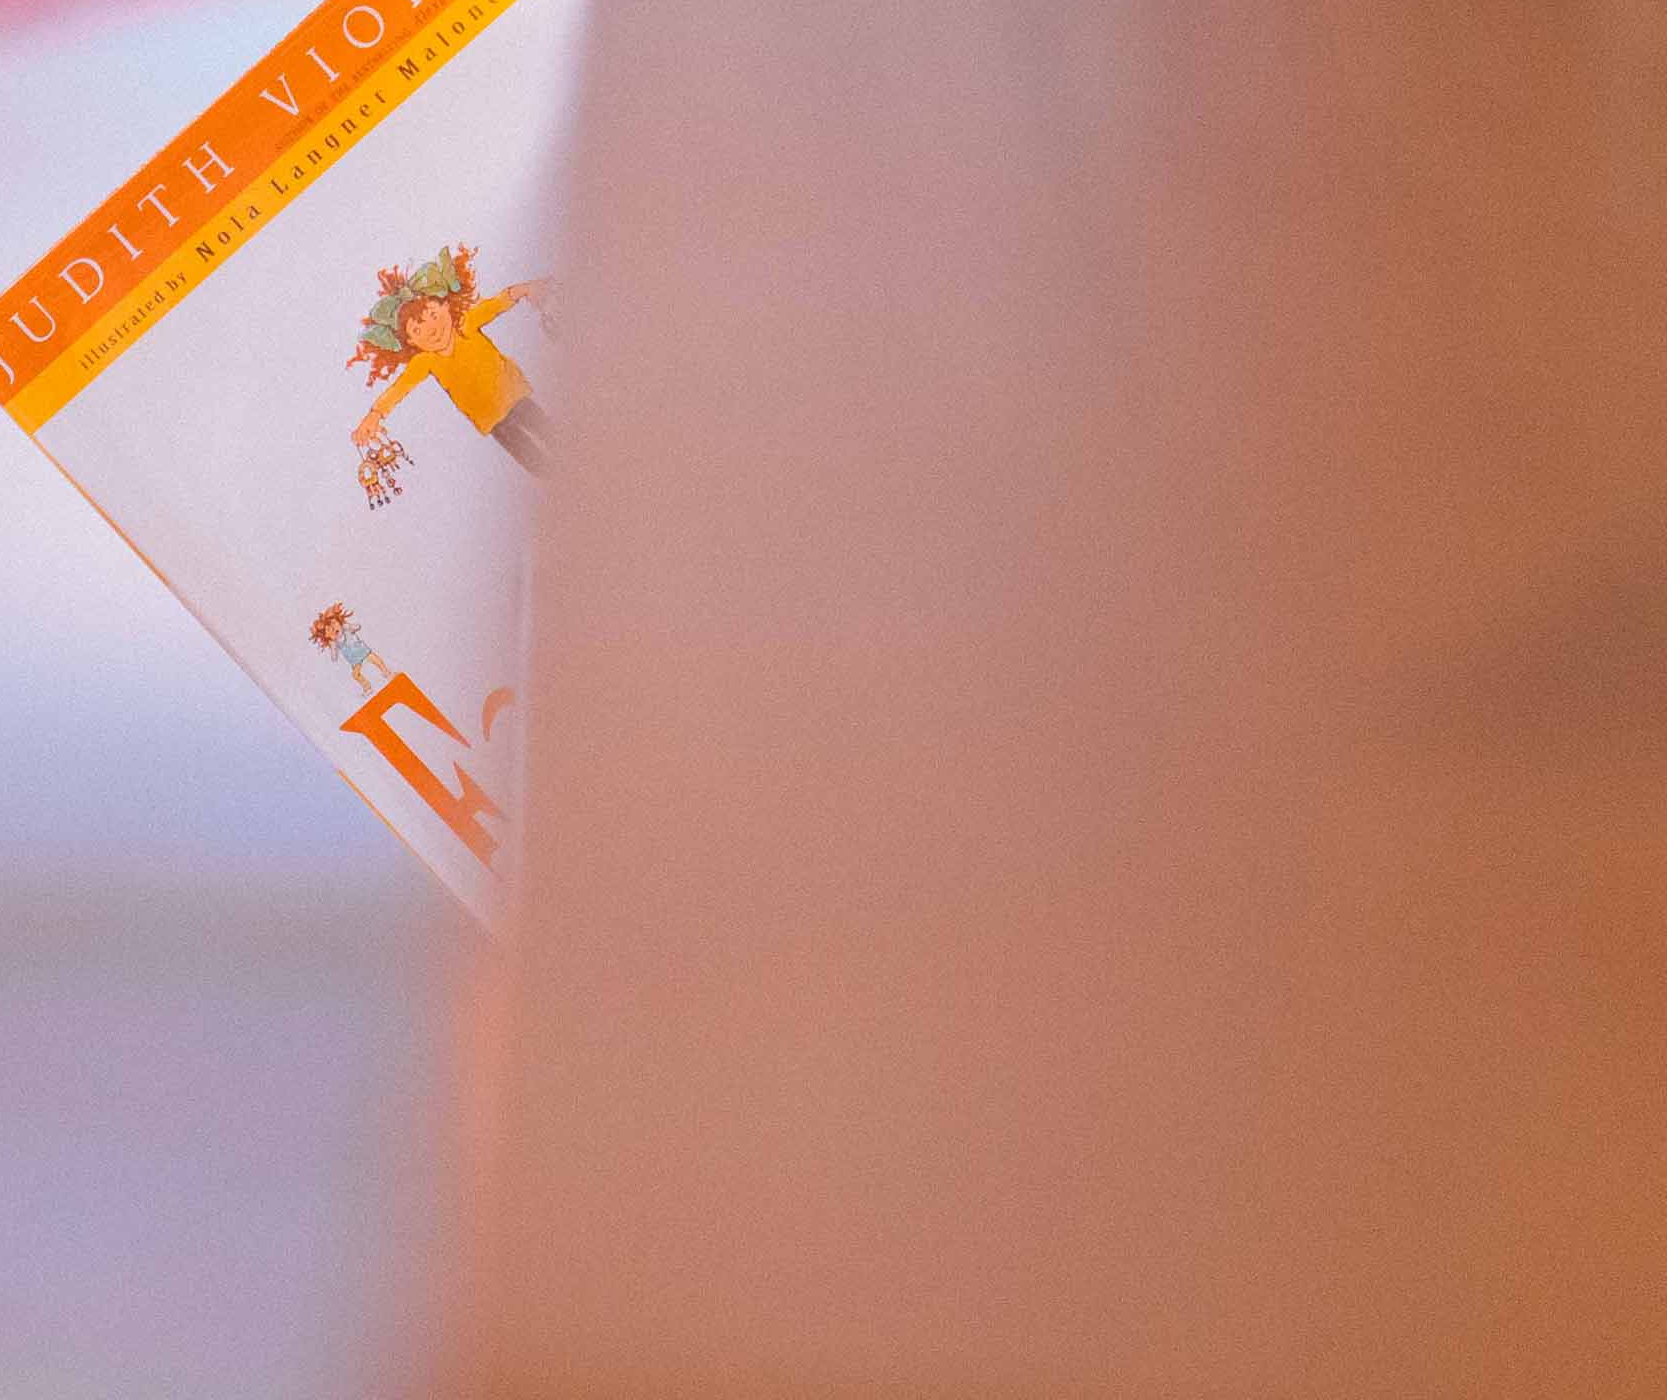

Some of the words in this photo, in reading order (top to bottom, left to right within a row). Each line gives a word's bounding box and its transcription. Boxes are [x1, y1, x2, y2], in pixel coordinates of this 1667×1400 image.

[77, 283, 167, 371] illustrated
[166, 268, 190, 306] by
[195, 201, 263, 265] Nola
[270, 87, 388, 196] Langner
